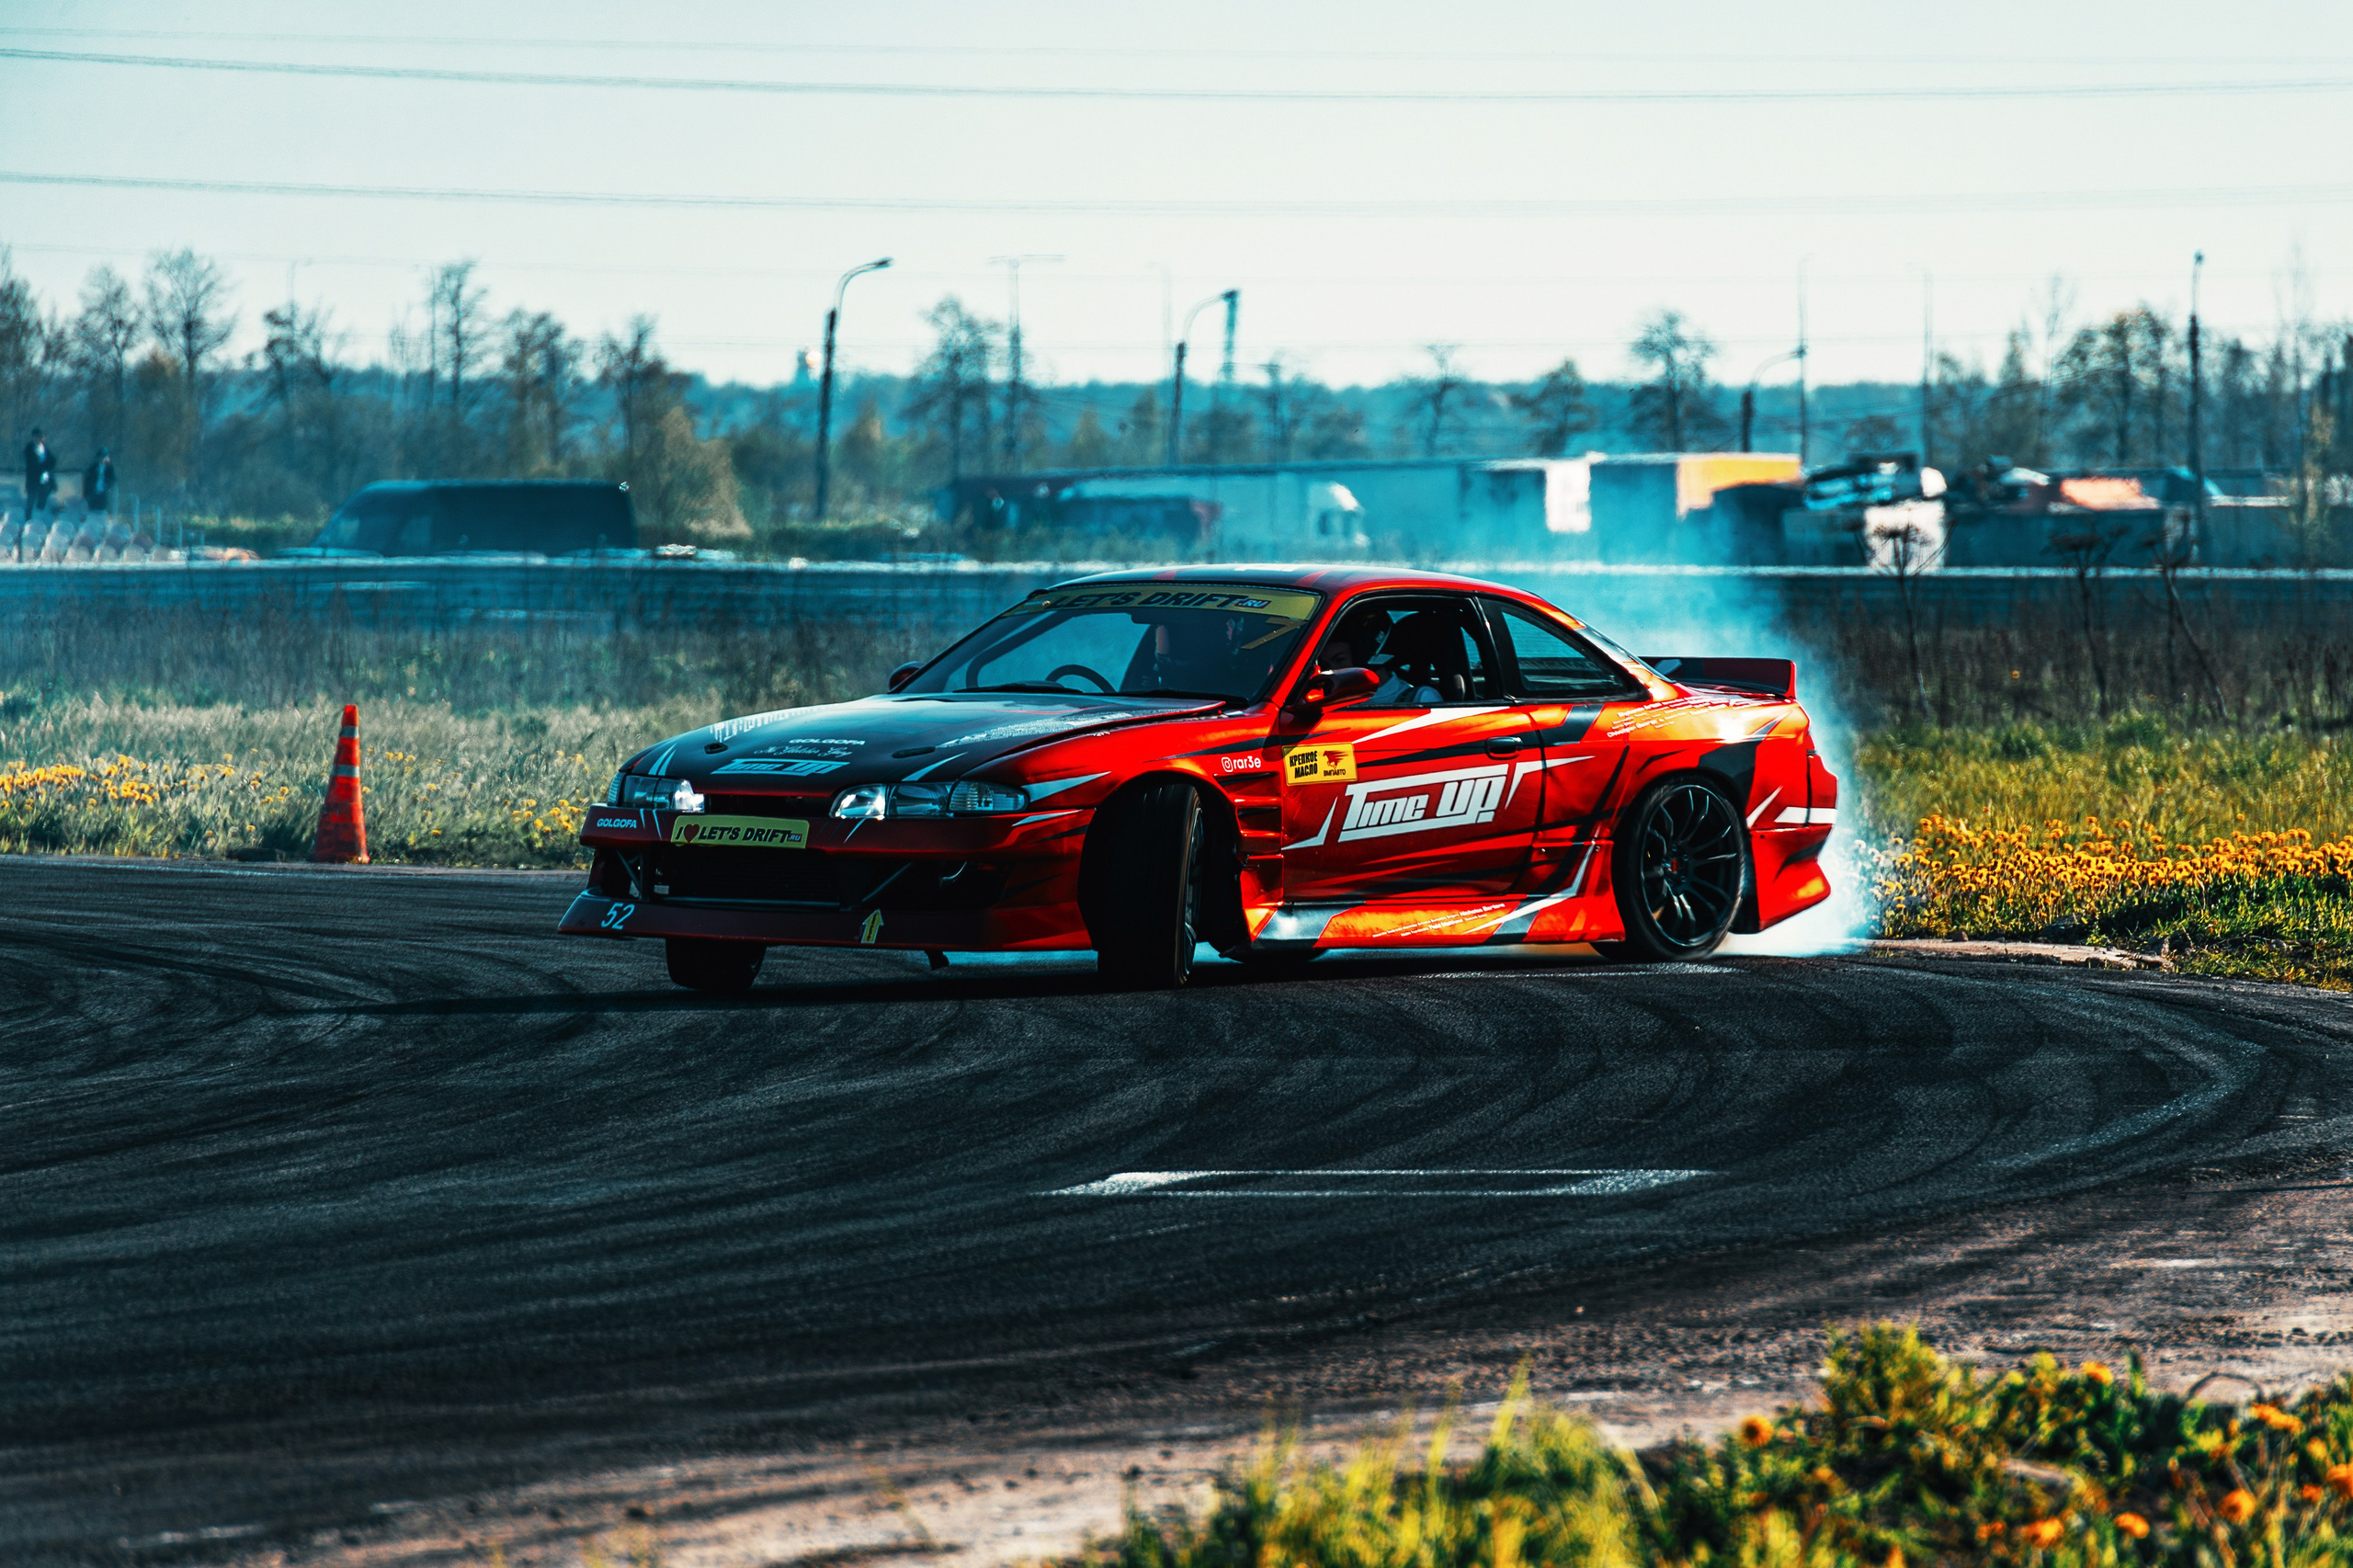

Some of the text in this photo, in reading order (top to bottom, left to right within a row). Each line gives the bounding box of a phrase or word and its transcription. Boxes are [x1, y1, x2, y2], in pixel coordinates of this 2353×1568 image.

[1045, 592, 1142, 609] LET'S
[1290, 751, 1318, 767] КРЕПКОЕ
[1294, 763, 1318, 778] МАСЛО
[597, 818, 637, 829] GOLGOFA
[675, 826, 684, 840] I
[699, 826, 741, 841] LET'S
[600, 903, 635, 930] 52
